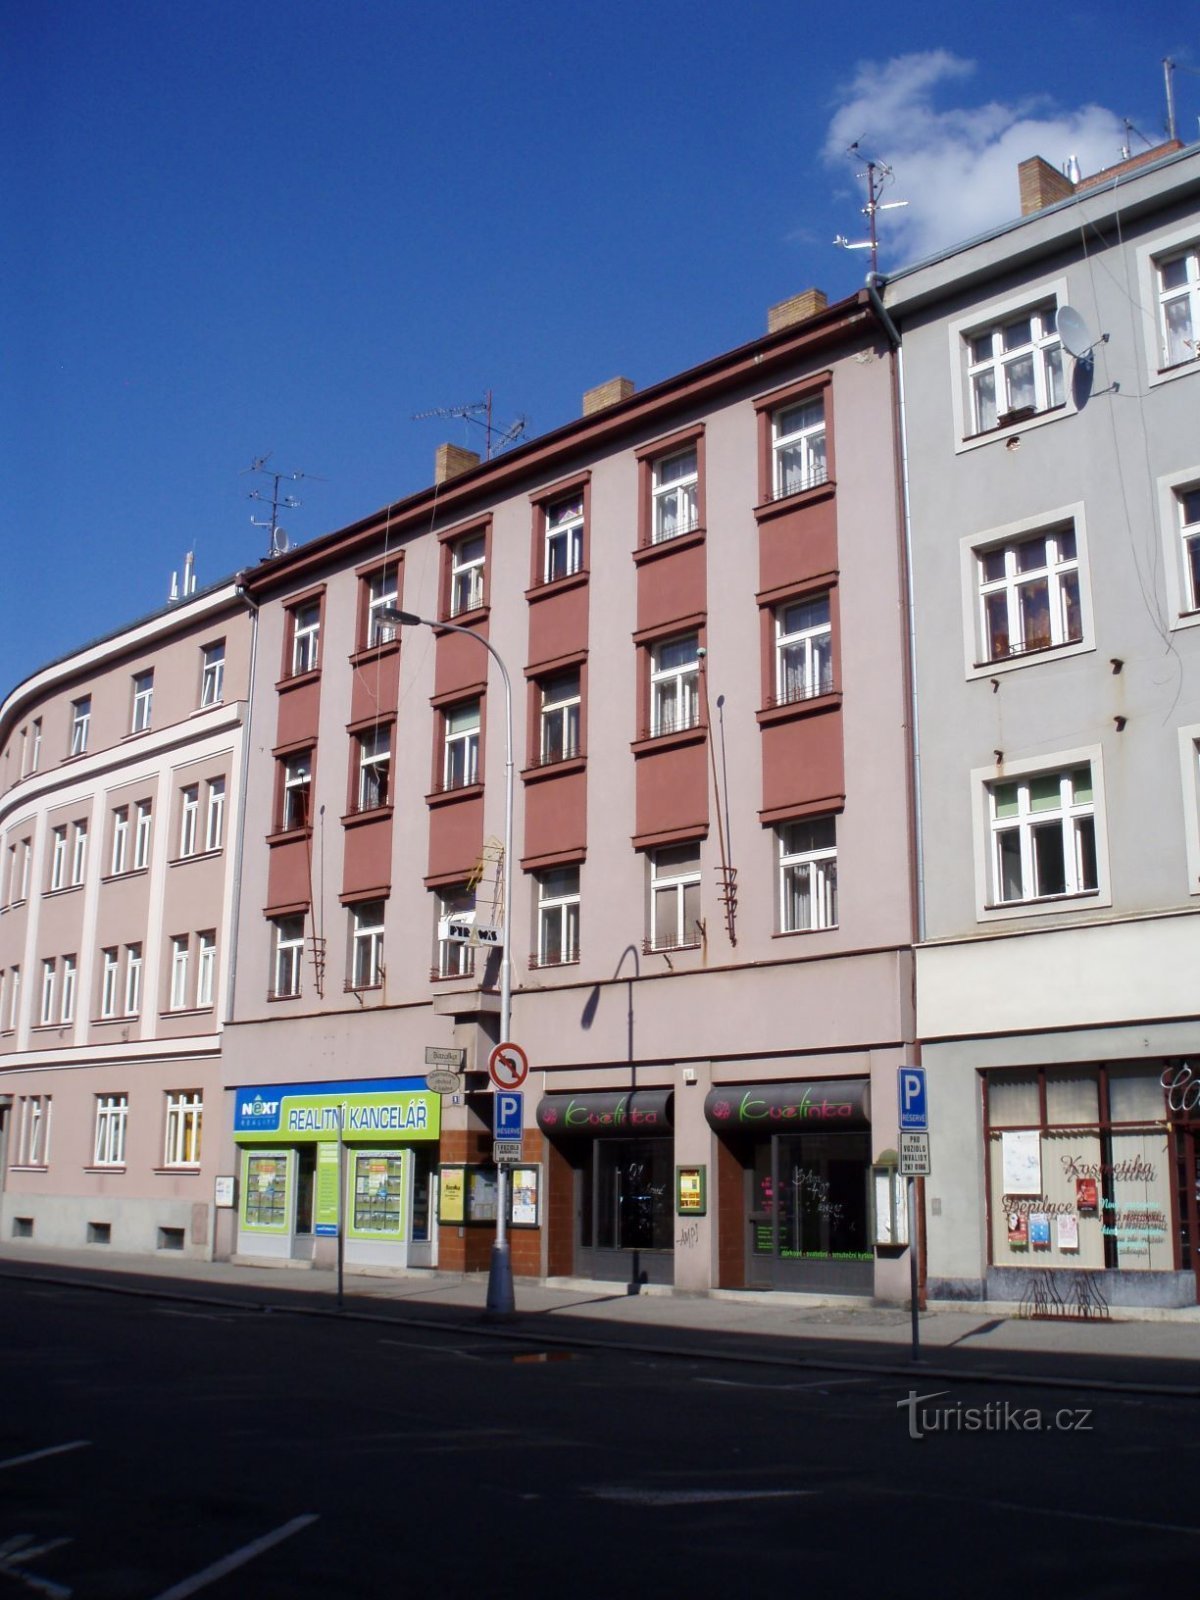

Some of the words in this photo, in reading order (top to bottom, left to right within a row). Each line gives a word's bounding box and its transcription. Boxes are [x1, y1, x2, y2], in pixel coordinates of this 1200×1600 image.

[904, 1074, 921, 1110] P
[288, 1101, 346, 1131] REALITNÍ
[349, 1099, 427, 1130] KANCELÁŘ
[500, 1097, 518, 1126] P
[902, 1154, 927, 1162] INVALIDY
[903, 1144, 926, 1153] VOZIDLO
[1060, 1154, 1152, 1176] Kosmetika
[1002, 1194, 1073, 1215] Depilace
